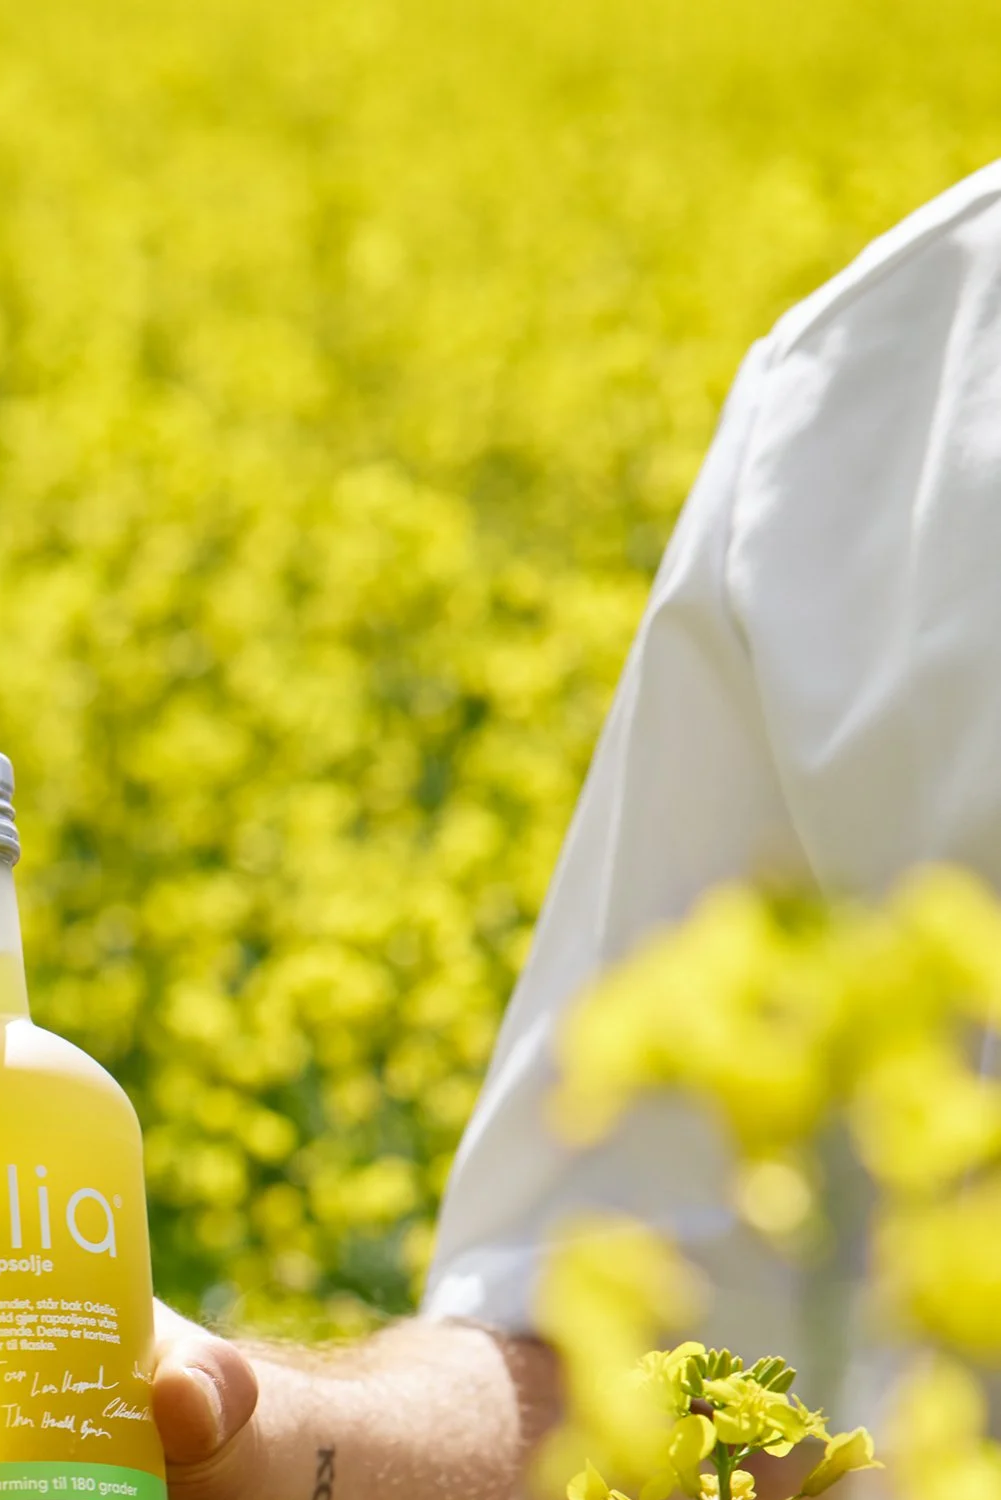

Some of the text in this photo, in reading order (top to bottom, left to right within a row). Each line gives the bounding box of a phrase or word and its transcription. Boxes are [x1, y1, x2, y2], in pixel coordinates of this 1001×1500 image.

[61, 1299, 82, 1311] bak
[36, 1325, 68, 1338] Dette
[70, 1328, 82, 1339] er
[53, 1476, 67, 1490] til
[71, 1477, 95, 1491] 180
[99, 1481, 138, 1497] grader
